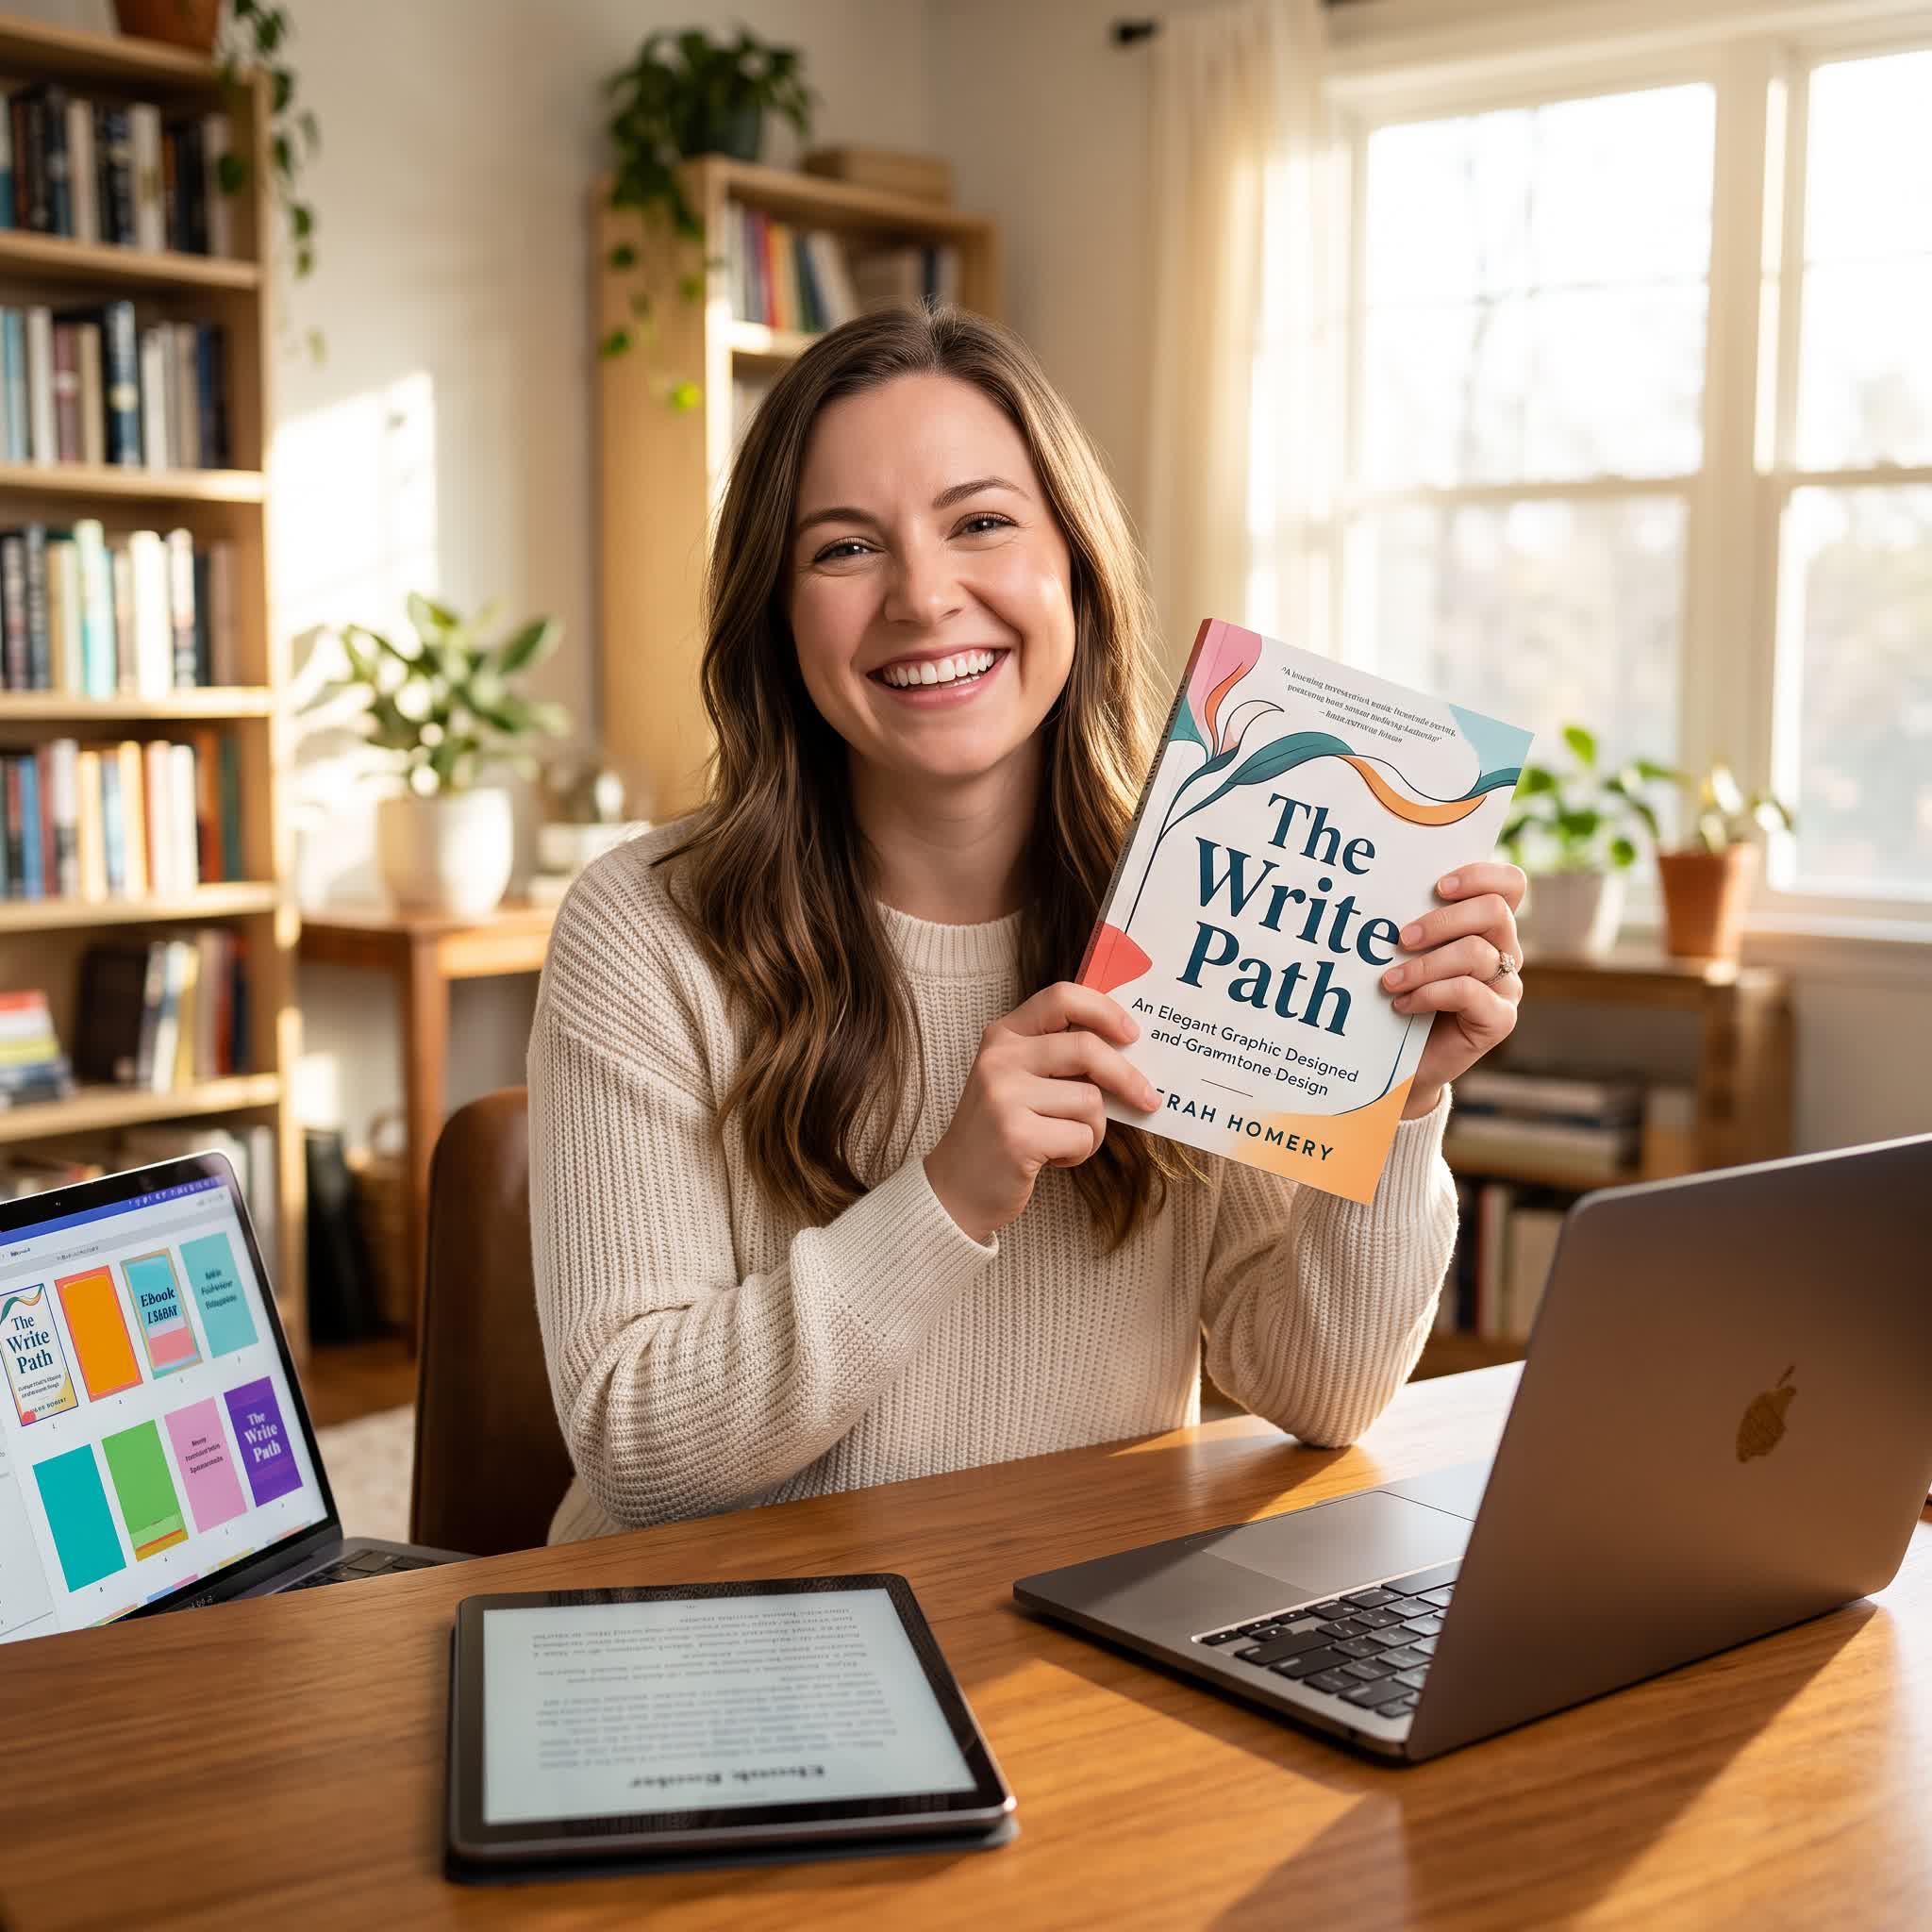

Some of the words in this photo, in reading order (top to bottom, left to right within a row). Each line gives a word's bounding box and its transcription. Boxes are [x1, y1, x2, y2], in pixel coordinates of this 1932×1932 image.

[1268, 793, 1376, 876] The
[1195, 836, 1401, 966] Write
[1175, 920, 1353, 1037] Path
[1131, 997, 1154, 1015] An
[1158, 1005, 1218, 1036] Elegant
[1221, 1026, 1282, 1058] Graphic
[1285, 1047, 1359, 1083] Designed
[1150, 1028, 1182, 1047] and
[1156, 1087, 1217, 1124] RAH
[1226, 1114, 1334, 1161] HOMERY
[140, 1287, 176, 1307] Ebook
[10, 1315, 35, 1331] The
[6, 1330, 51, 1355] Write
[16, 1349, 54, 1374] Path
[246, 1412, 267, 1426] The
[243, 1424, 278, 1445] Write
[252, 1440, 282, 1463] Path
